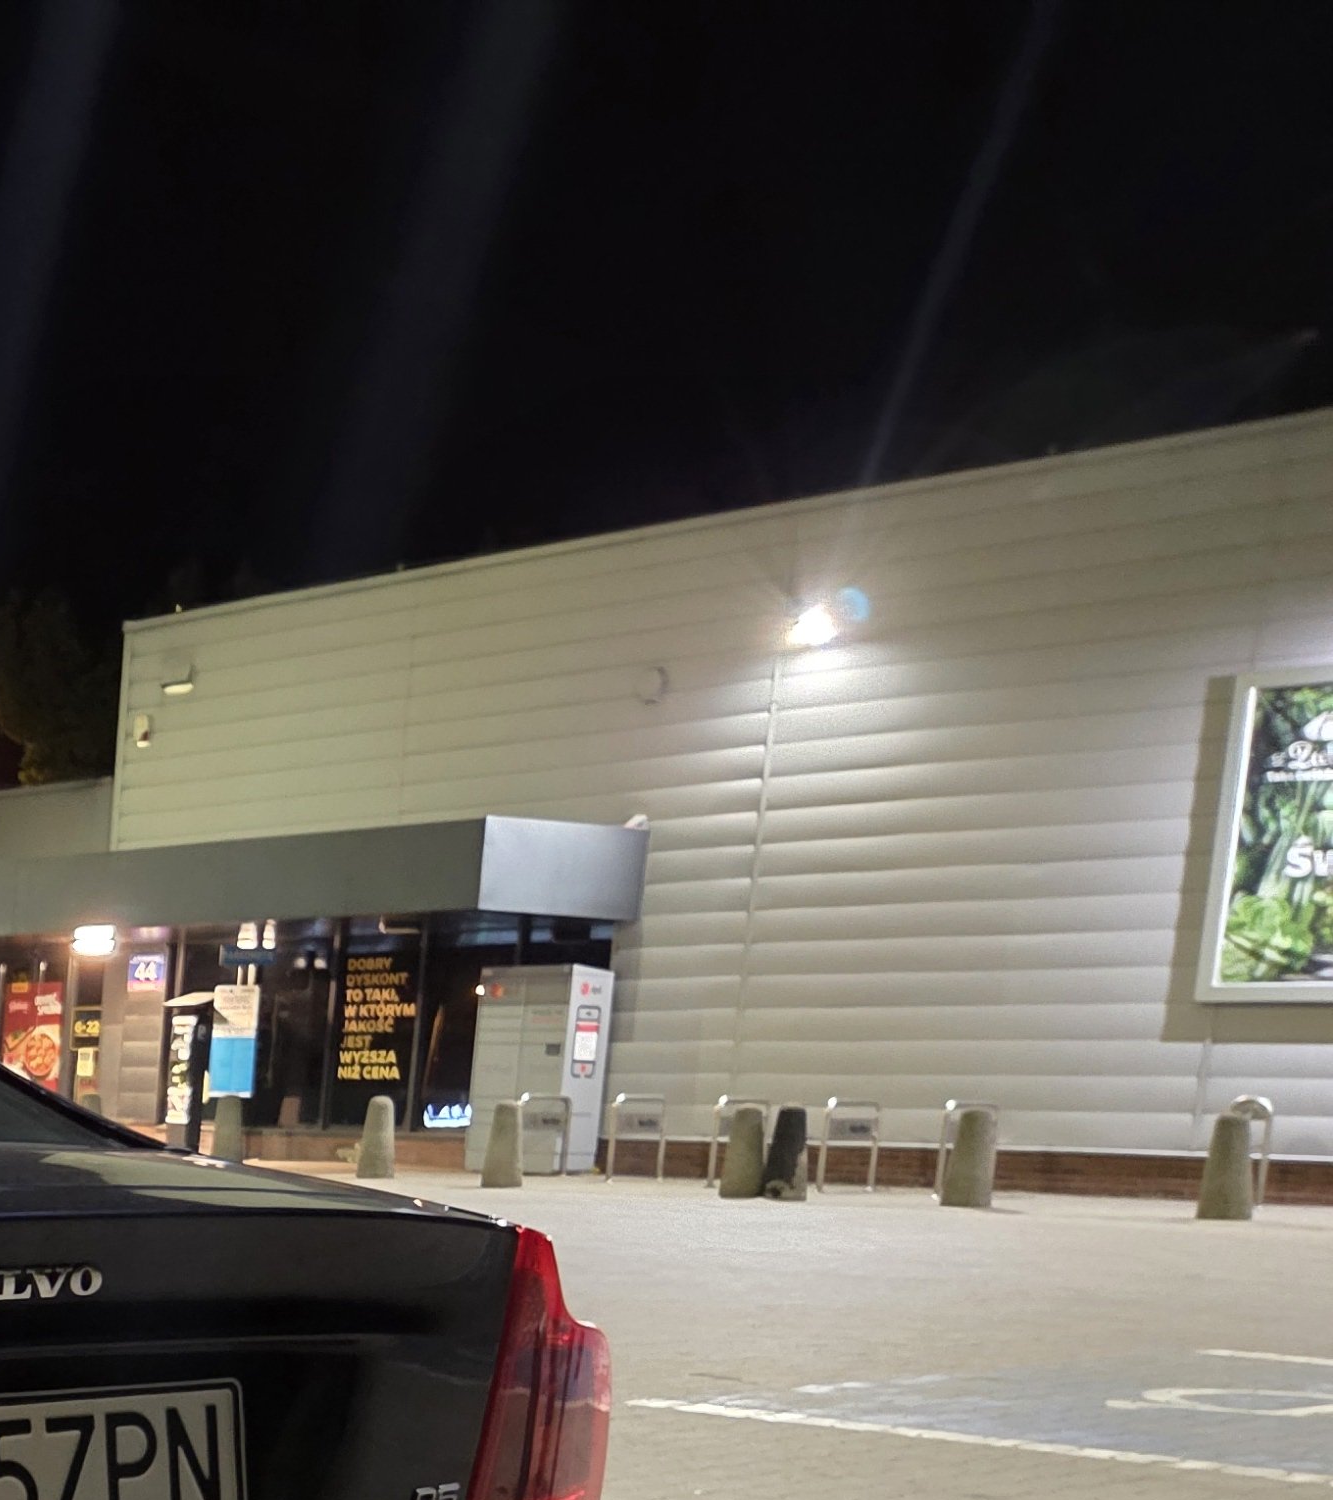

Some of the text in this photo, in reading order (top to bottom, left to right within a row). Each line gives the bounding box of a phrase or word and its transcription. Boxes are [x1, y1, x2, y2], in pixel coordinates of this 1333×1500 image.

[134, 962, 158, 981] 44
[347, 957, 393, 971] DOBRY
[346, 972, 409, 987] DYSKONT
[346, 988, 364, 1002] TO
[345, 1000, 416, 1018] W KTÓRYM
[343, 1017, 394, 1033] JAKOŚĆ
[341, 1035, 373, 1049] JEST
[337, 1063, 400, 1080] NIŻ CENA
